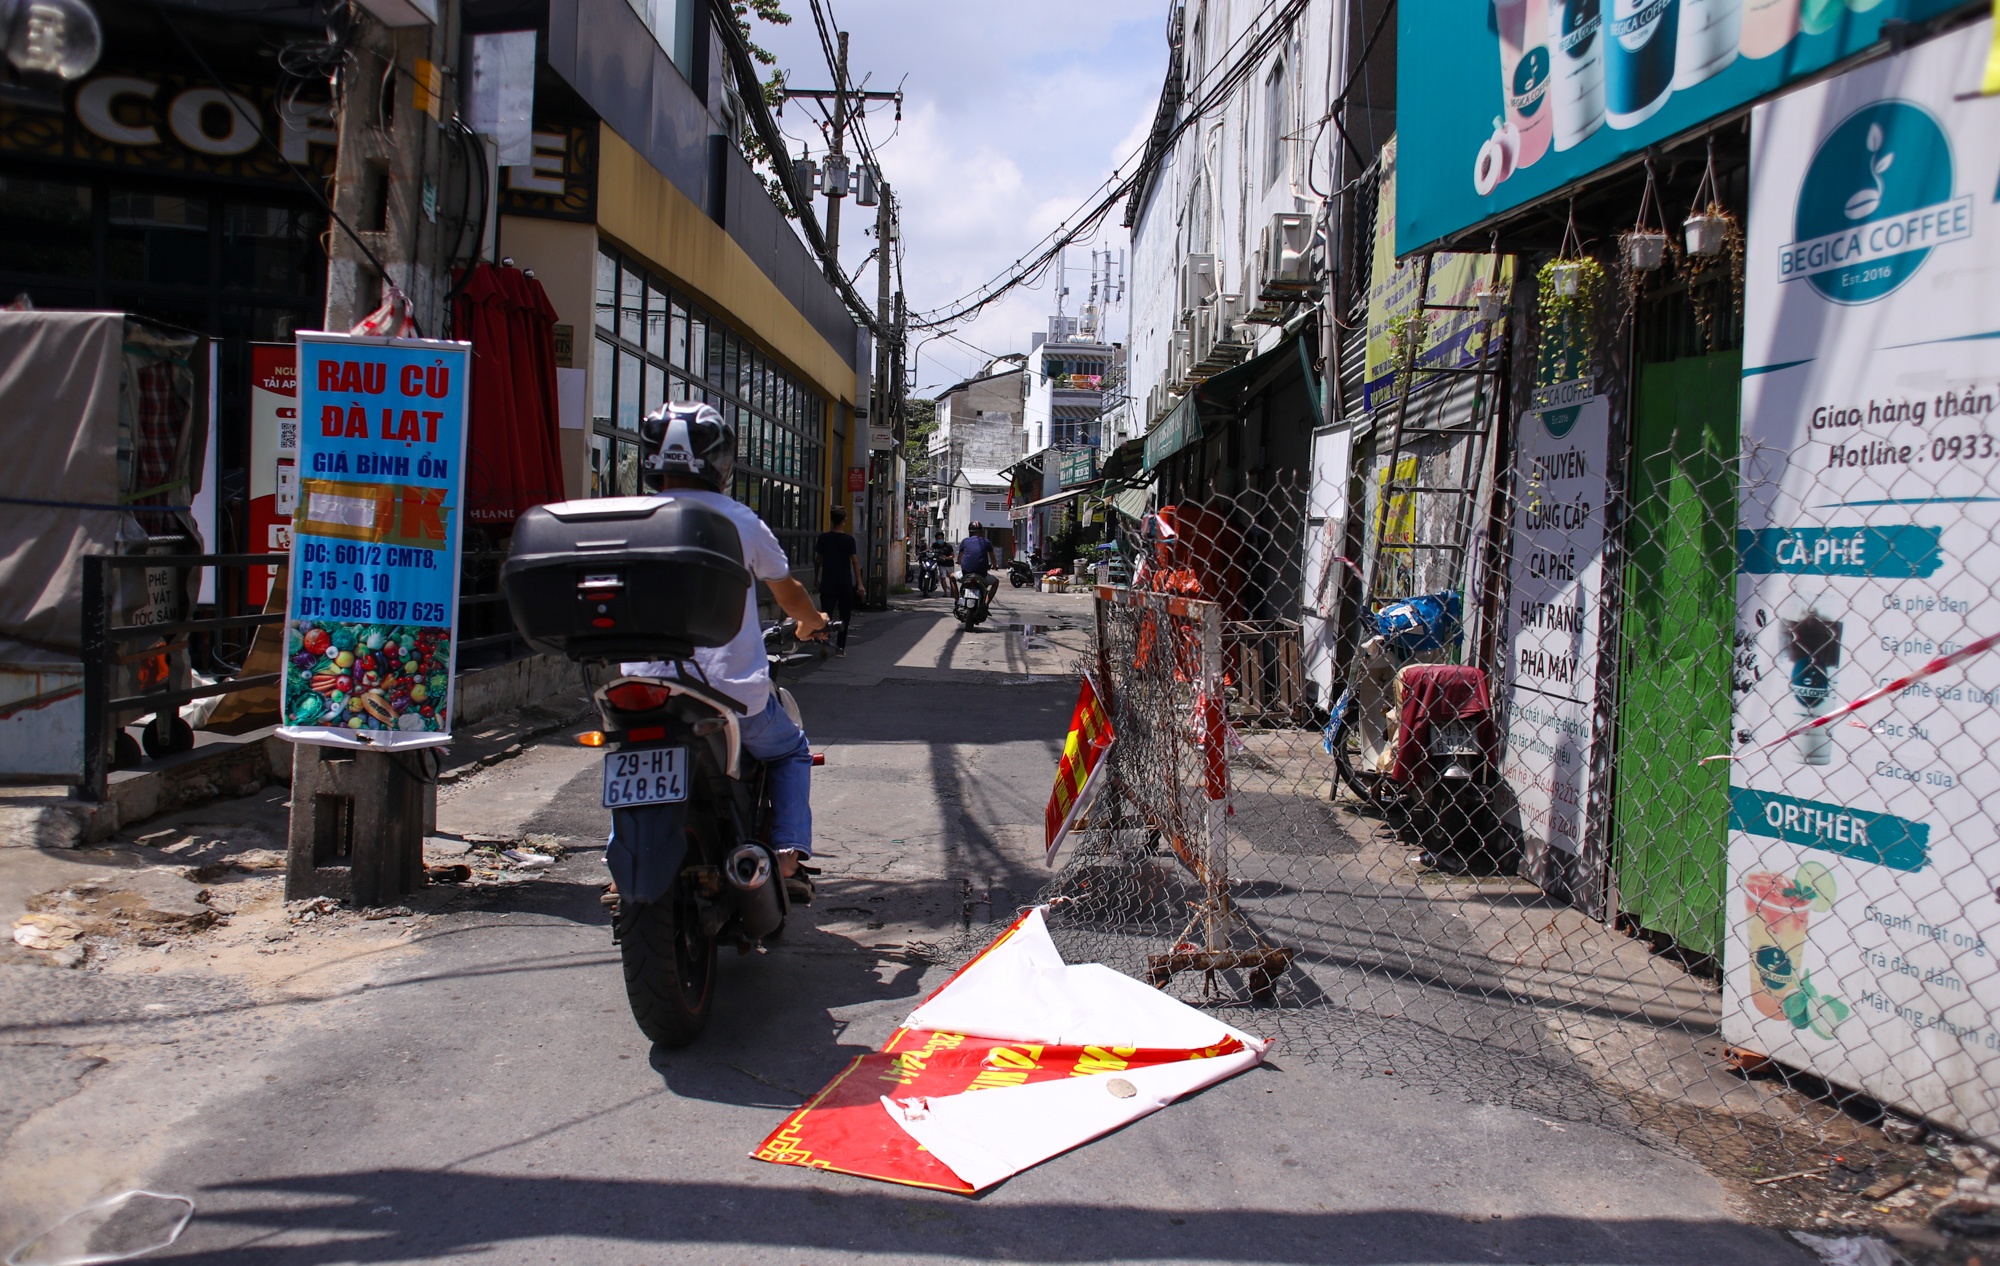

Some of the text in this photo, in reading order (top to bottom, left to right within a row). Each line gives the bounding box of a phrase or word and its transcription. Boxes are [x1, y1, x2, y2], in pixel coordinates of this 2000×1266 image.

[1781, 204, 1968, 276] BEGICA COFFEE
[318, 358, 449, 398] RAU CỦ
[1812, 384, 1992, 430] Giao hàng thần
[320, 401, 444, 447] ĐÀ LẠT
[313, 451, 448, 478] GIÁ BÌNH ỔN
[664, 452, 688, 461] INDEX
[1534, 445, 1586, 481] CHUYÊN
[1828, 441, 1912, 468] Hotline
[304, 543, 437, 570] ĐC: 601/2 CMT8,
[1776, 532, 1810, 565] CÀ
[1530, 547, 1575, 581] CÀ PHÊ
[148, 570, 168, 587] PHÊ
[302, 570, 314, 589] P.
[319, 571, 337, 590] 15
[353, 572, 367, 593] Q.
[371, 573, 390, 593] 10
[301, 597, 445, 623] ĐT: 0985 087 625
[1882, 594, 1968, 614] Cà phê đen
[1881, 636, 1899, 652] Cà
[1904, 637, 1933, 656] phê
[1520, 648, 1578, 684] PHA MÁY
[616, 750, 674, 778] 29-H1
[1875, 761, 1952, 788] Cacao sữa
[608, 774, 681, 803] 648.64
[1765, 801, 1869, 847] ORTHER
[1864, 904, 1912, 932] Chanh
[1953, 933, 1986, 957] ong
[1861, 989, 1890, 1014] Mật
